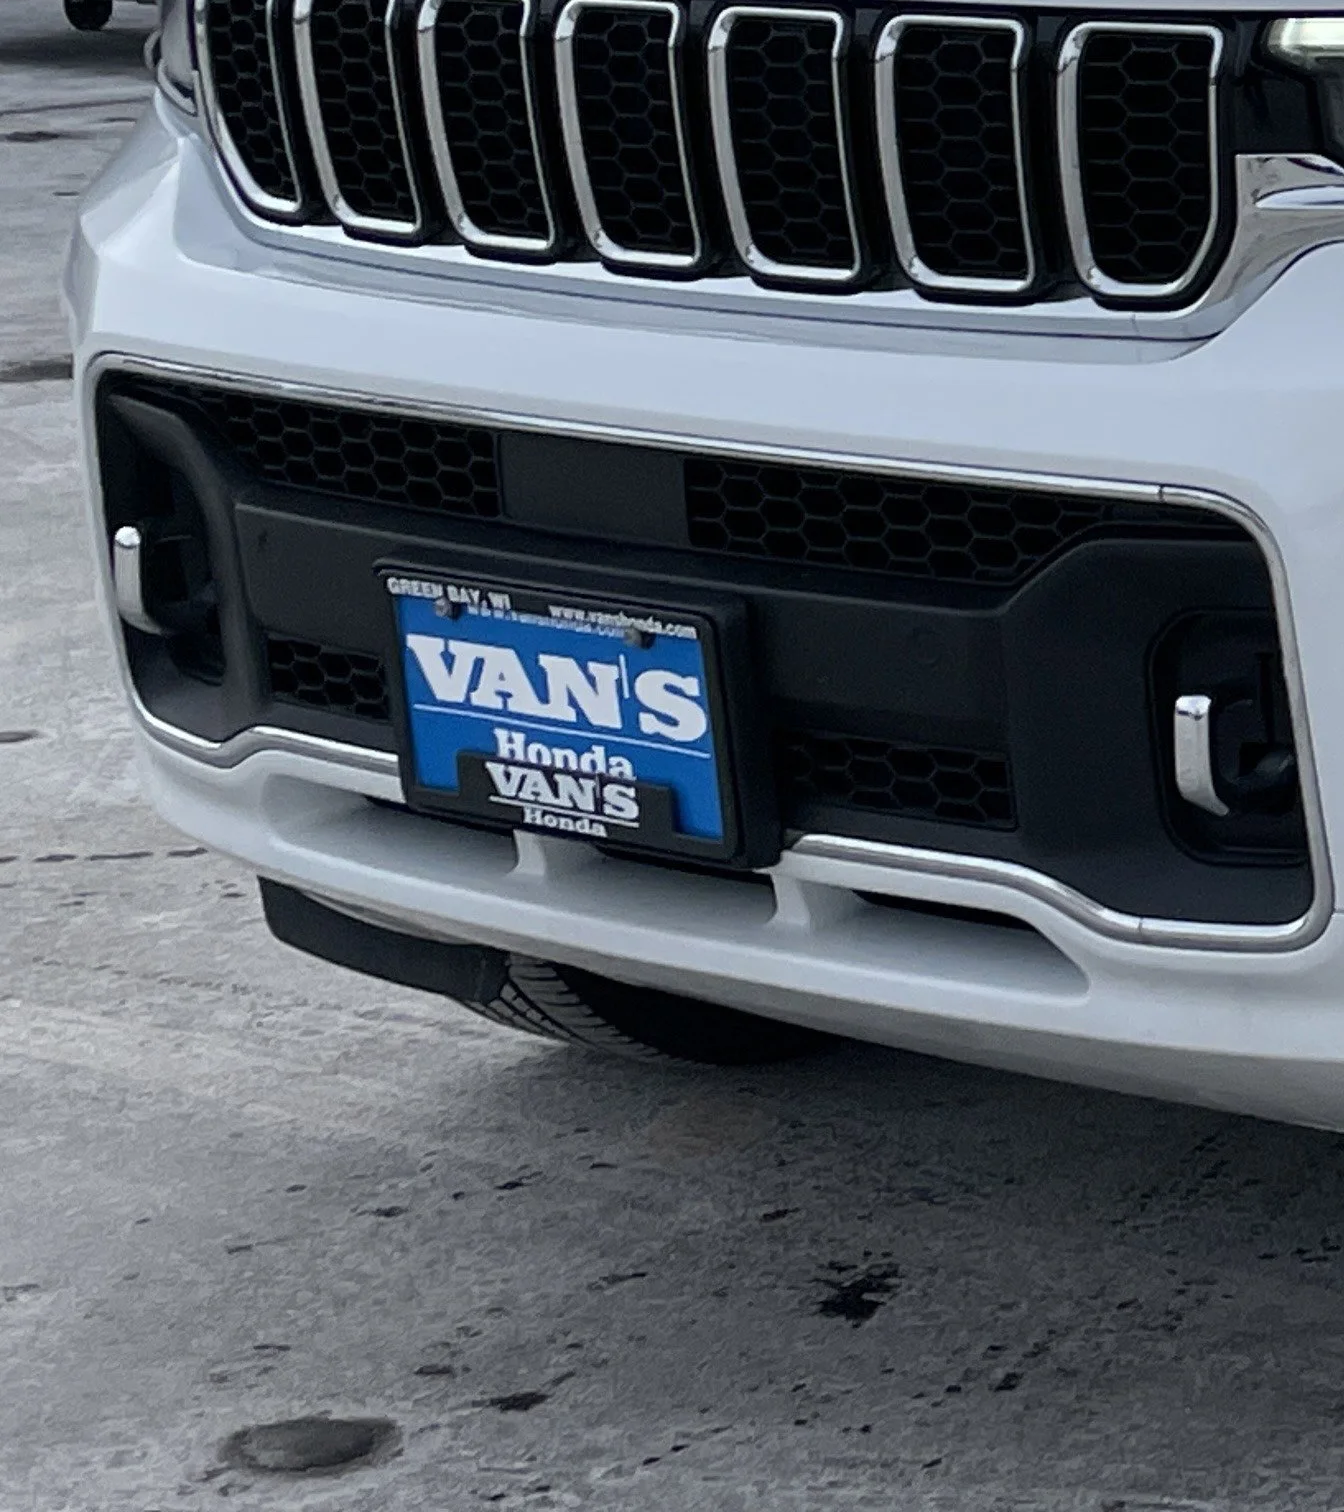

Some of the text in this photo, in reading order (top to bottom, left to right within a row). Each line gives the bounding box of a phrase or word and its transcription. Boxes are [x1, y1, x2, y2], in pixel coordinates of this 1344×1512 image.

[387, 577, 443, 598] GREEN
[488, 591, 511, 610] WI
[406, 633, 708, 742] VAN'S
[493, 728, 636, 782] Honda
[522, 806, 607, 838] Honda
